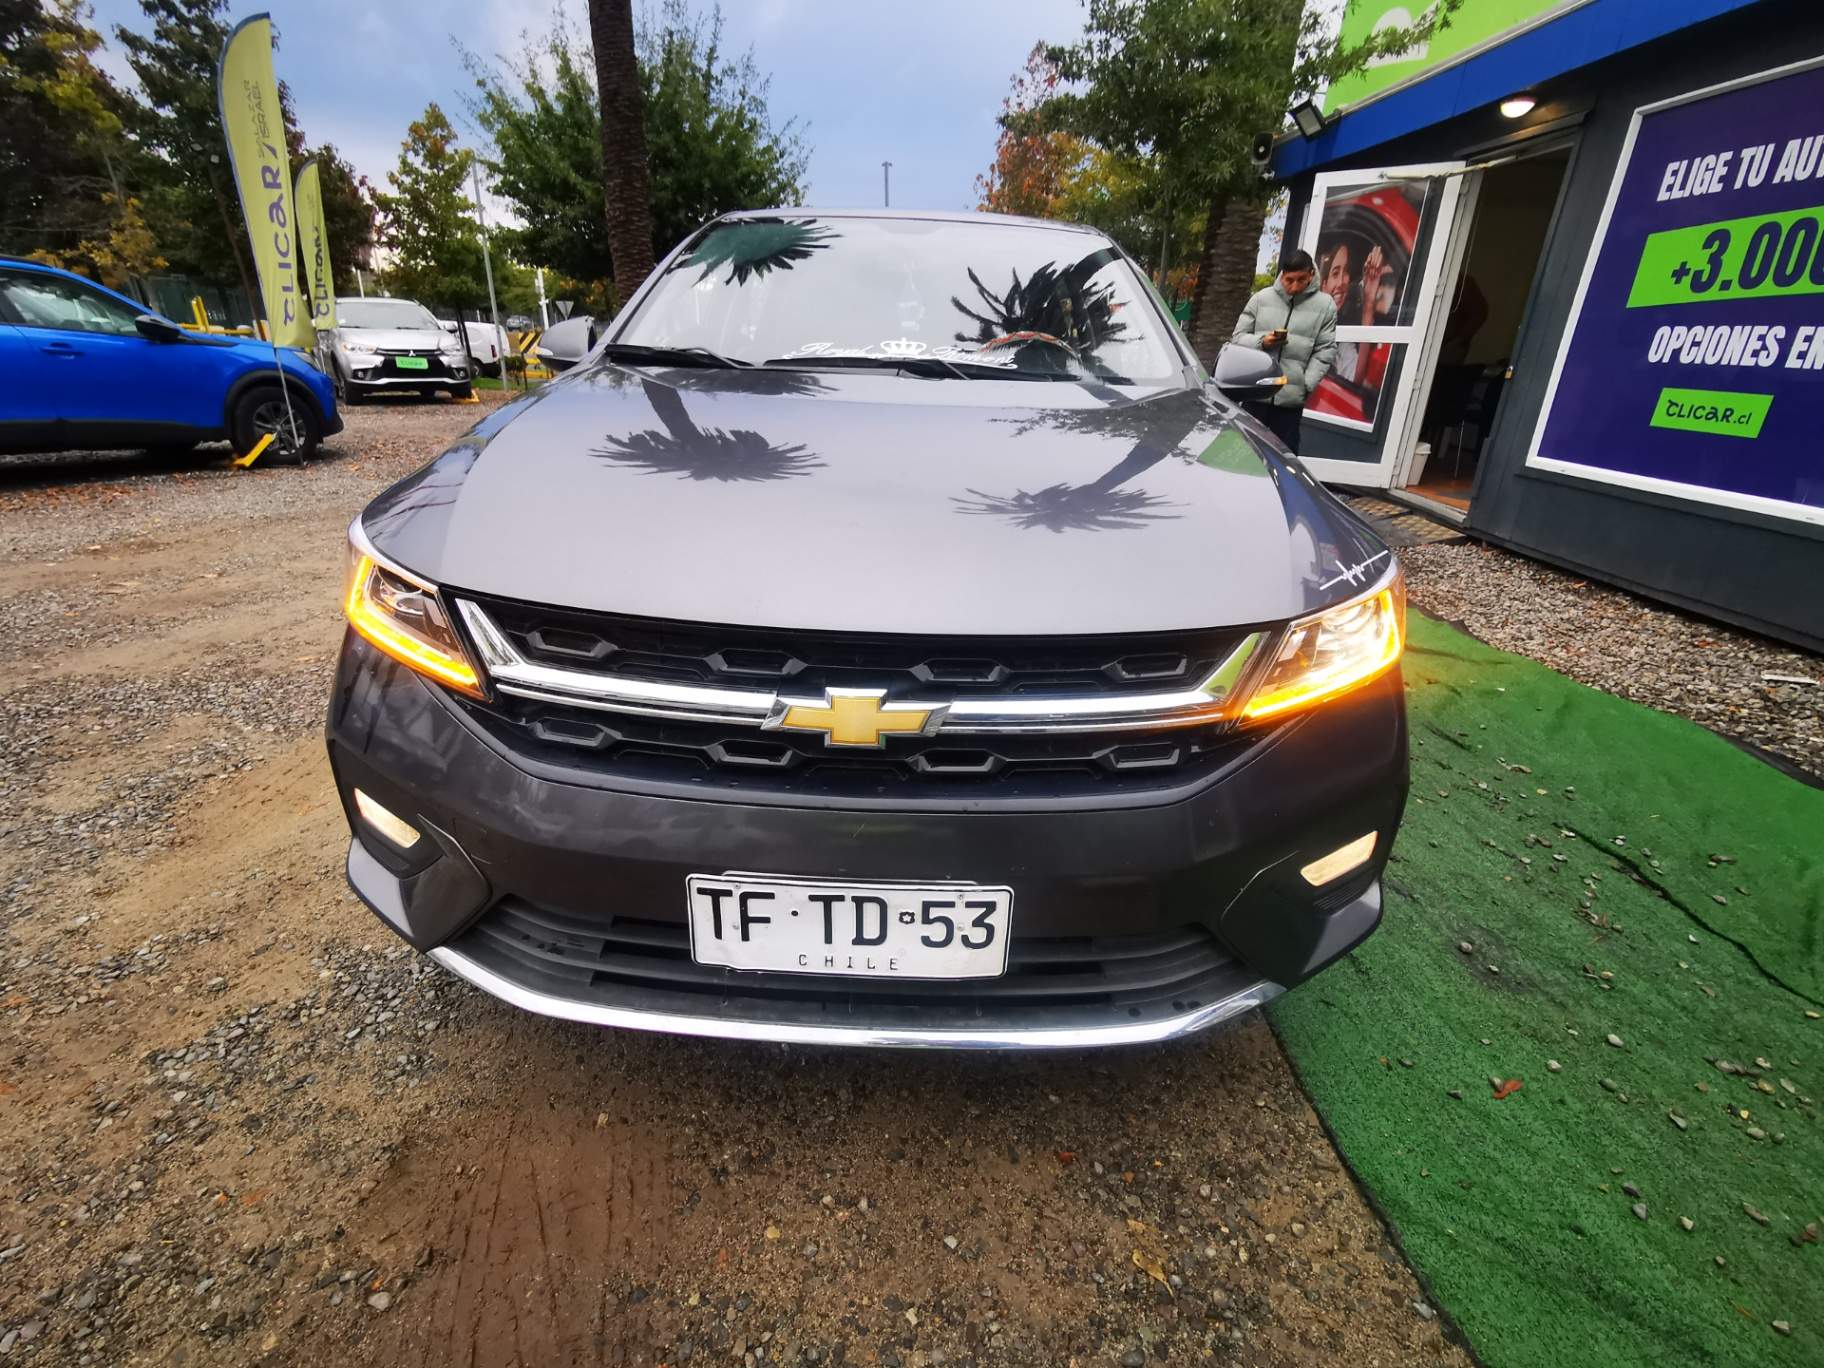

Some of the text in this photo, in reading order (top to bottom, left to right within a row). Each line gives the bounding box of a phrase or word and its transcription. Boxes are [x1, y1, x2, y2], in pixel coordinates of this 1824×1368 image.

[1656, 151, 1734, 202] ELIGE
[1733, 143, 1776, 190] TU
[1648, 325, 1786, 367] OPCIONES
[798, 954, 899, 971] CHILE
